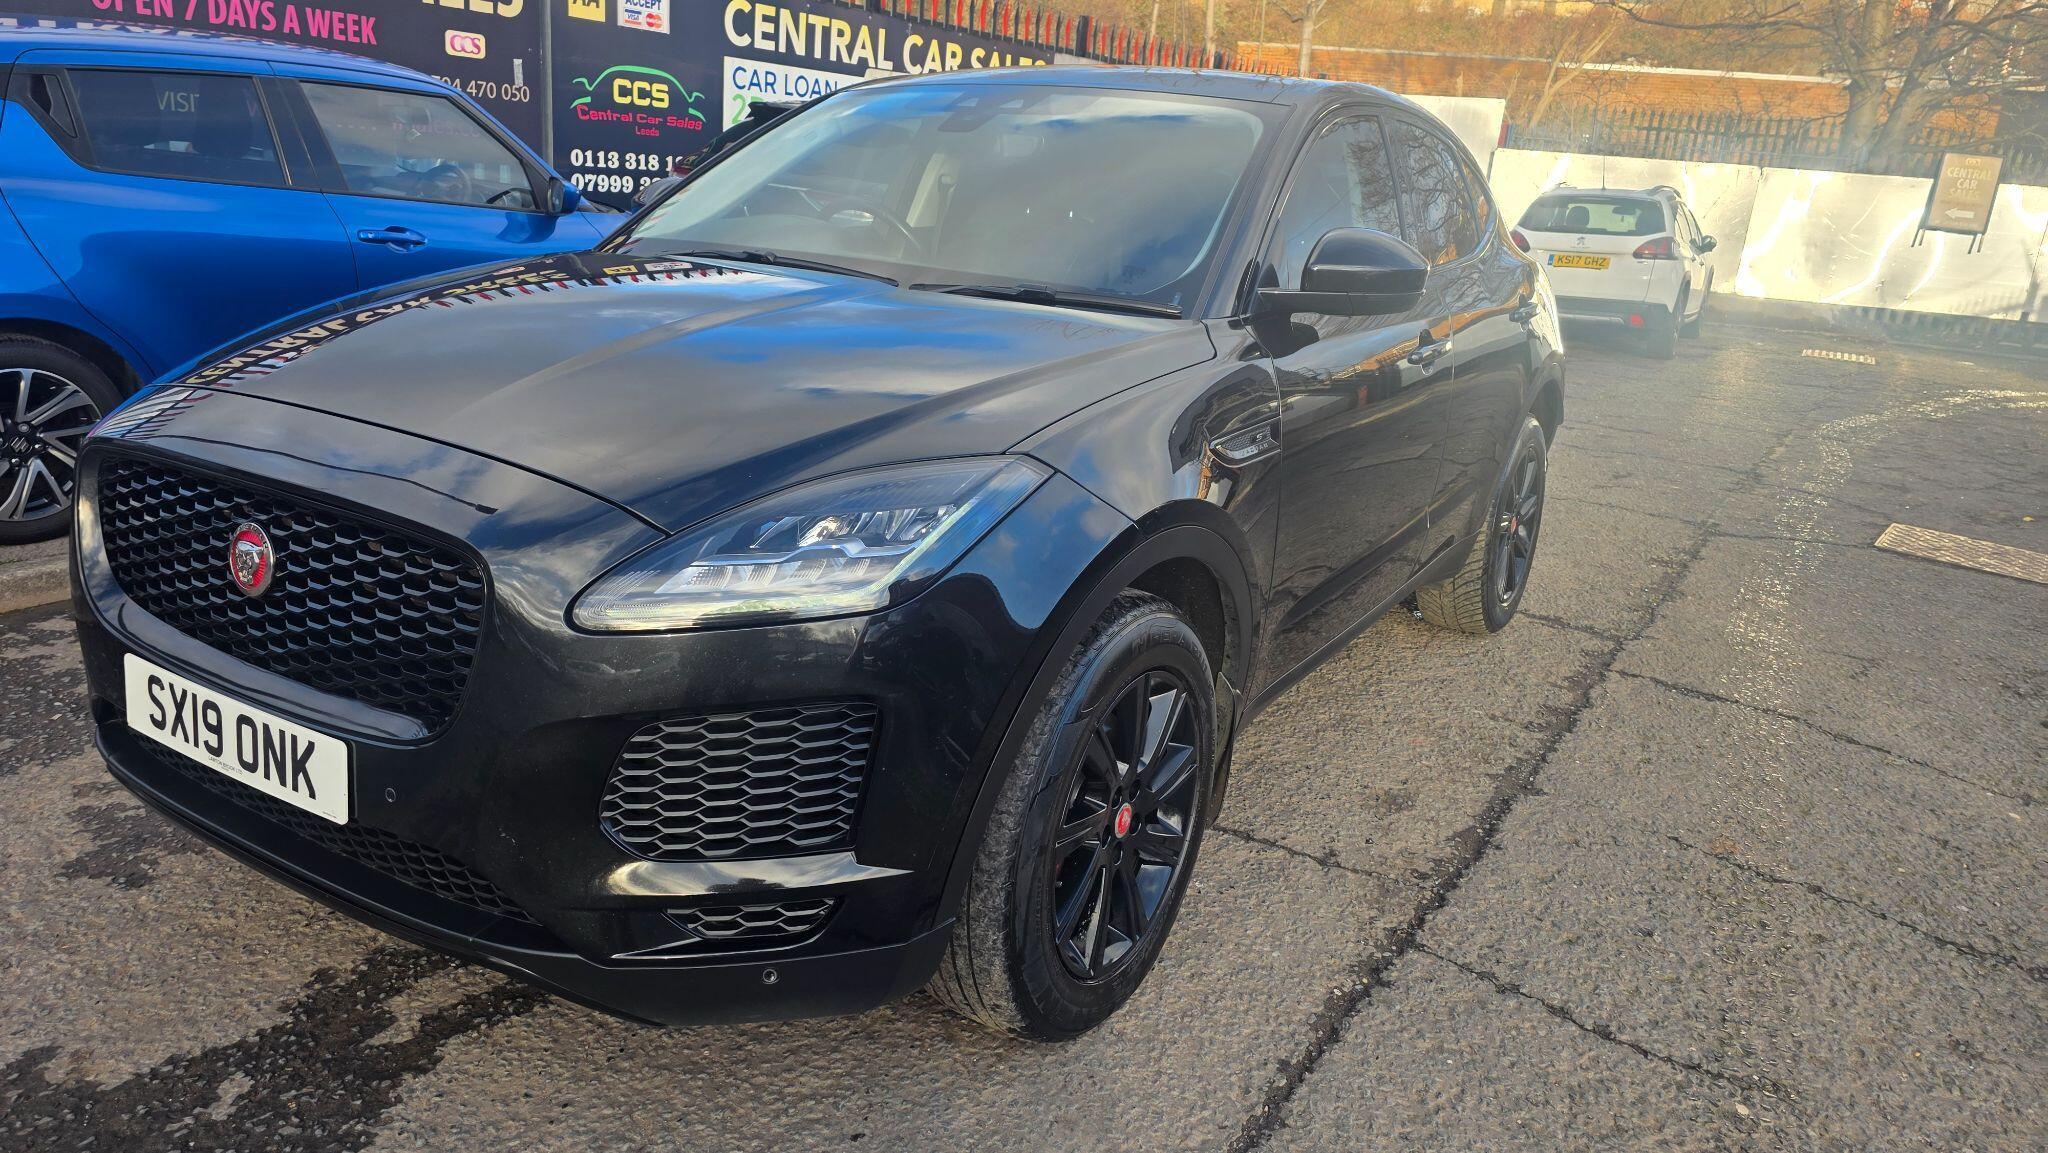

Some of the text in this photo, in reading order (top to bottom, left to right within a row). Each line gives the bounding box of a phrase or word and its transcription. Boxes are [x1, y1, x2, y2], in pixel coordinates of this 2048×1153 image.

[208, 0, 277, 32] DAYS
[283, 4, 301, 36] A
[305, 7, 377, 46] WEEK
[450, 34, 481, 55] CCS
[724, 0, 963, 76] CENTRAL CAR
[466, 80, 497, 99] 470
[501, 83, 530, 103] 050
[732, 65, 777, 95] CAR
[156, 90, 200, 113] VISI
[613, 78, 670, 109] CCS
[576, 104, 703, 131] Central Car Sales
[635, 126, 660, 137] Leeds
[570, 148, 620, 169] 0113
[624, 152, 660, 171] 318
[570, 172, 634, 194] 07999
[1947, 167, 1993, 181] CENTRAL
[1956, 178, 1978, 190] CAR
[1557, 254, 1582, 265] KS17
[147, 674, 317, 801] SX19 ONK
